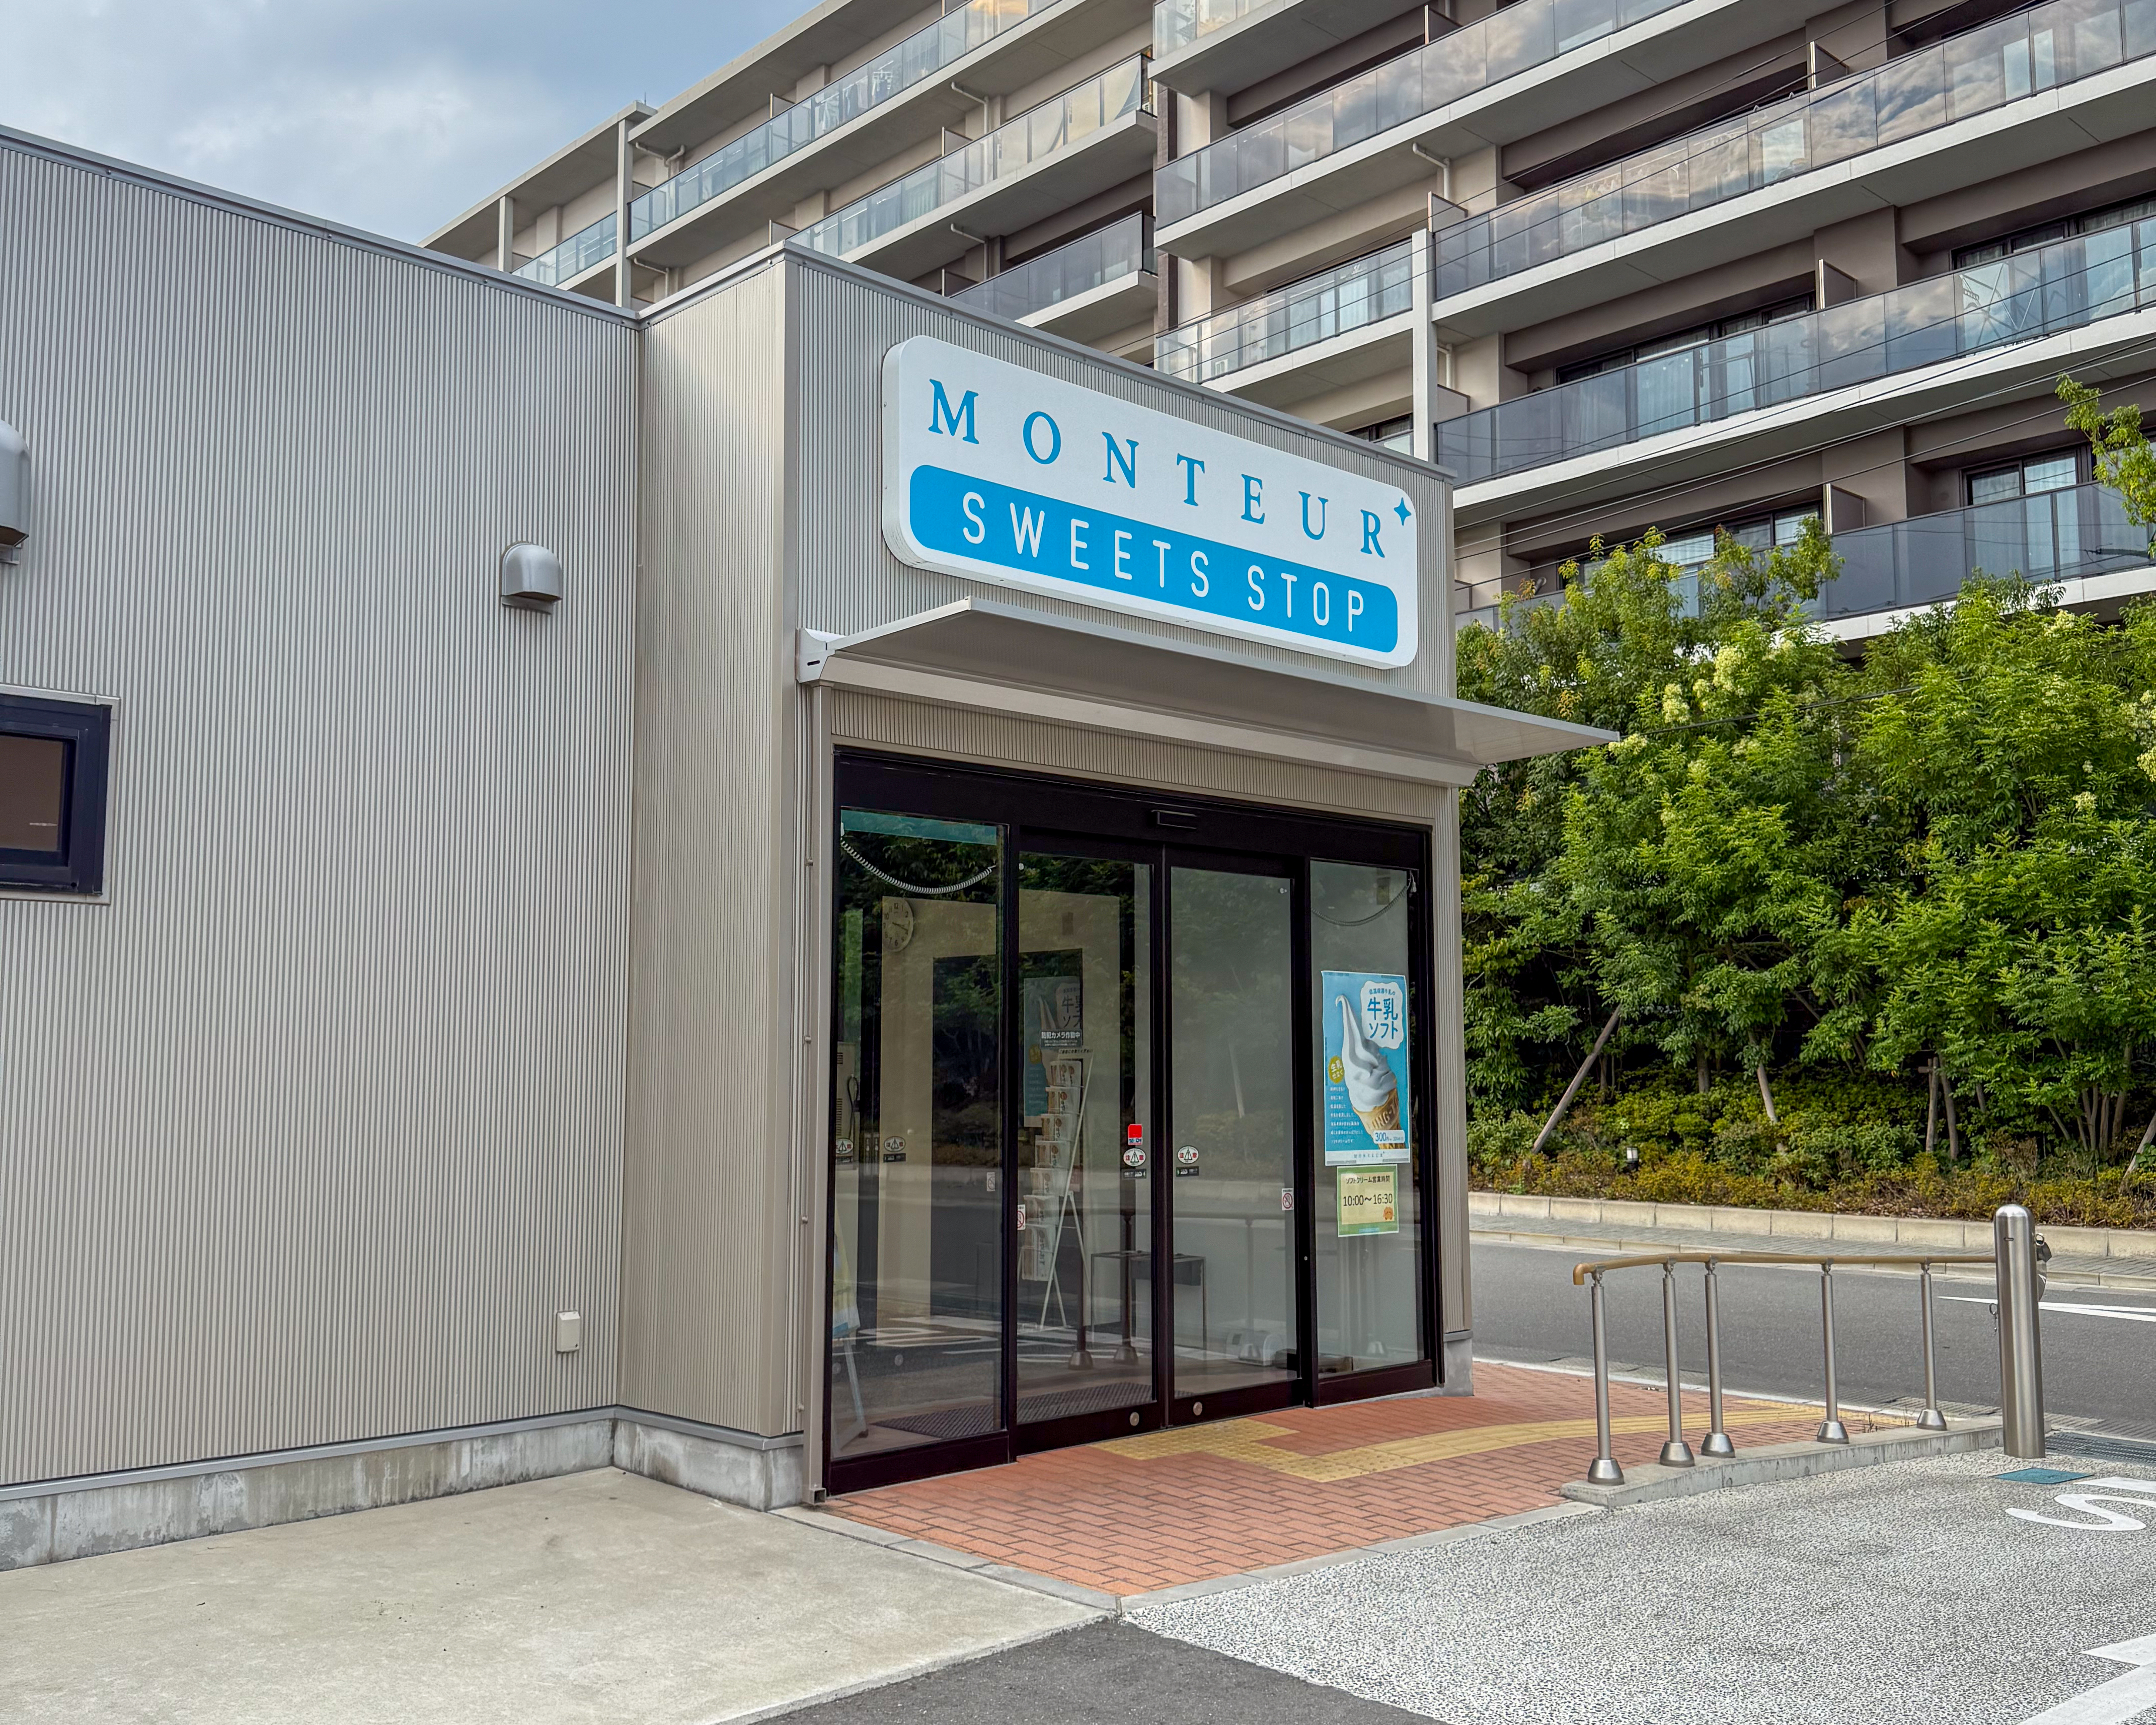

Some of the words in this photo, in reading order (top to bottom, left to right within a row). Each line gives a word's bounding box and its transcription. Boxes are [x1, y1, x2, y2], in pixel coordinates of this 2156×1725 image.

[928, 379, 1385, 558] MONTEUR
[963, 491, 1209, 597] SWEETS
[1248, 564, 1364, 632] STOP
[1367, 997, 1398, 1020] 牛乳
[1369, 1021, 1398, 1039] ソフト
